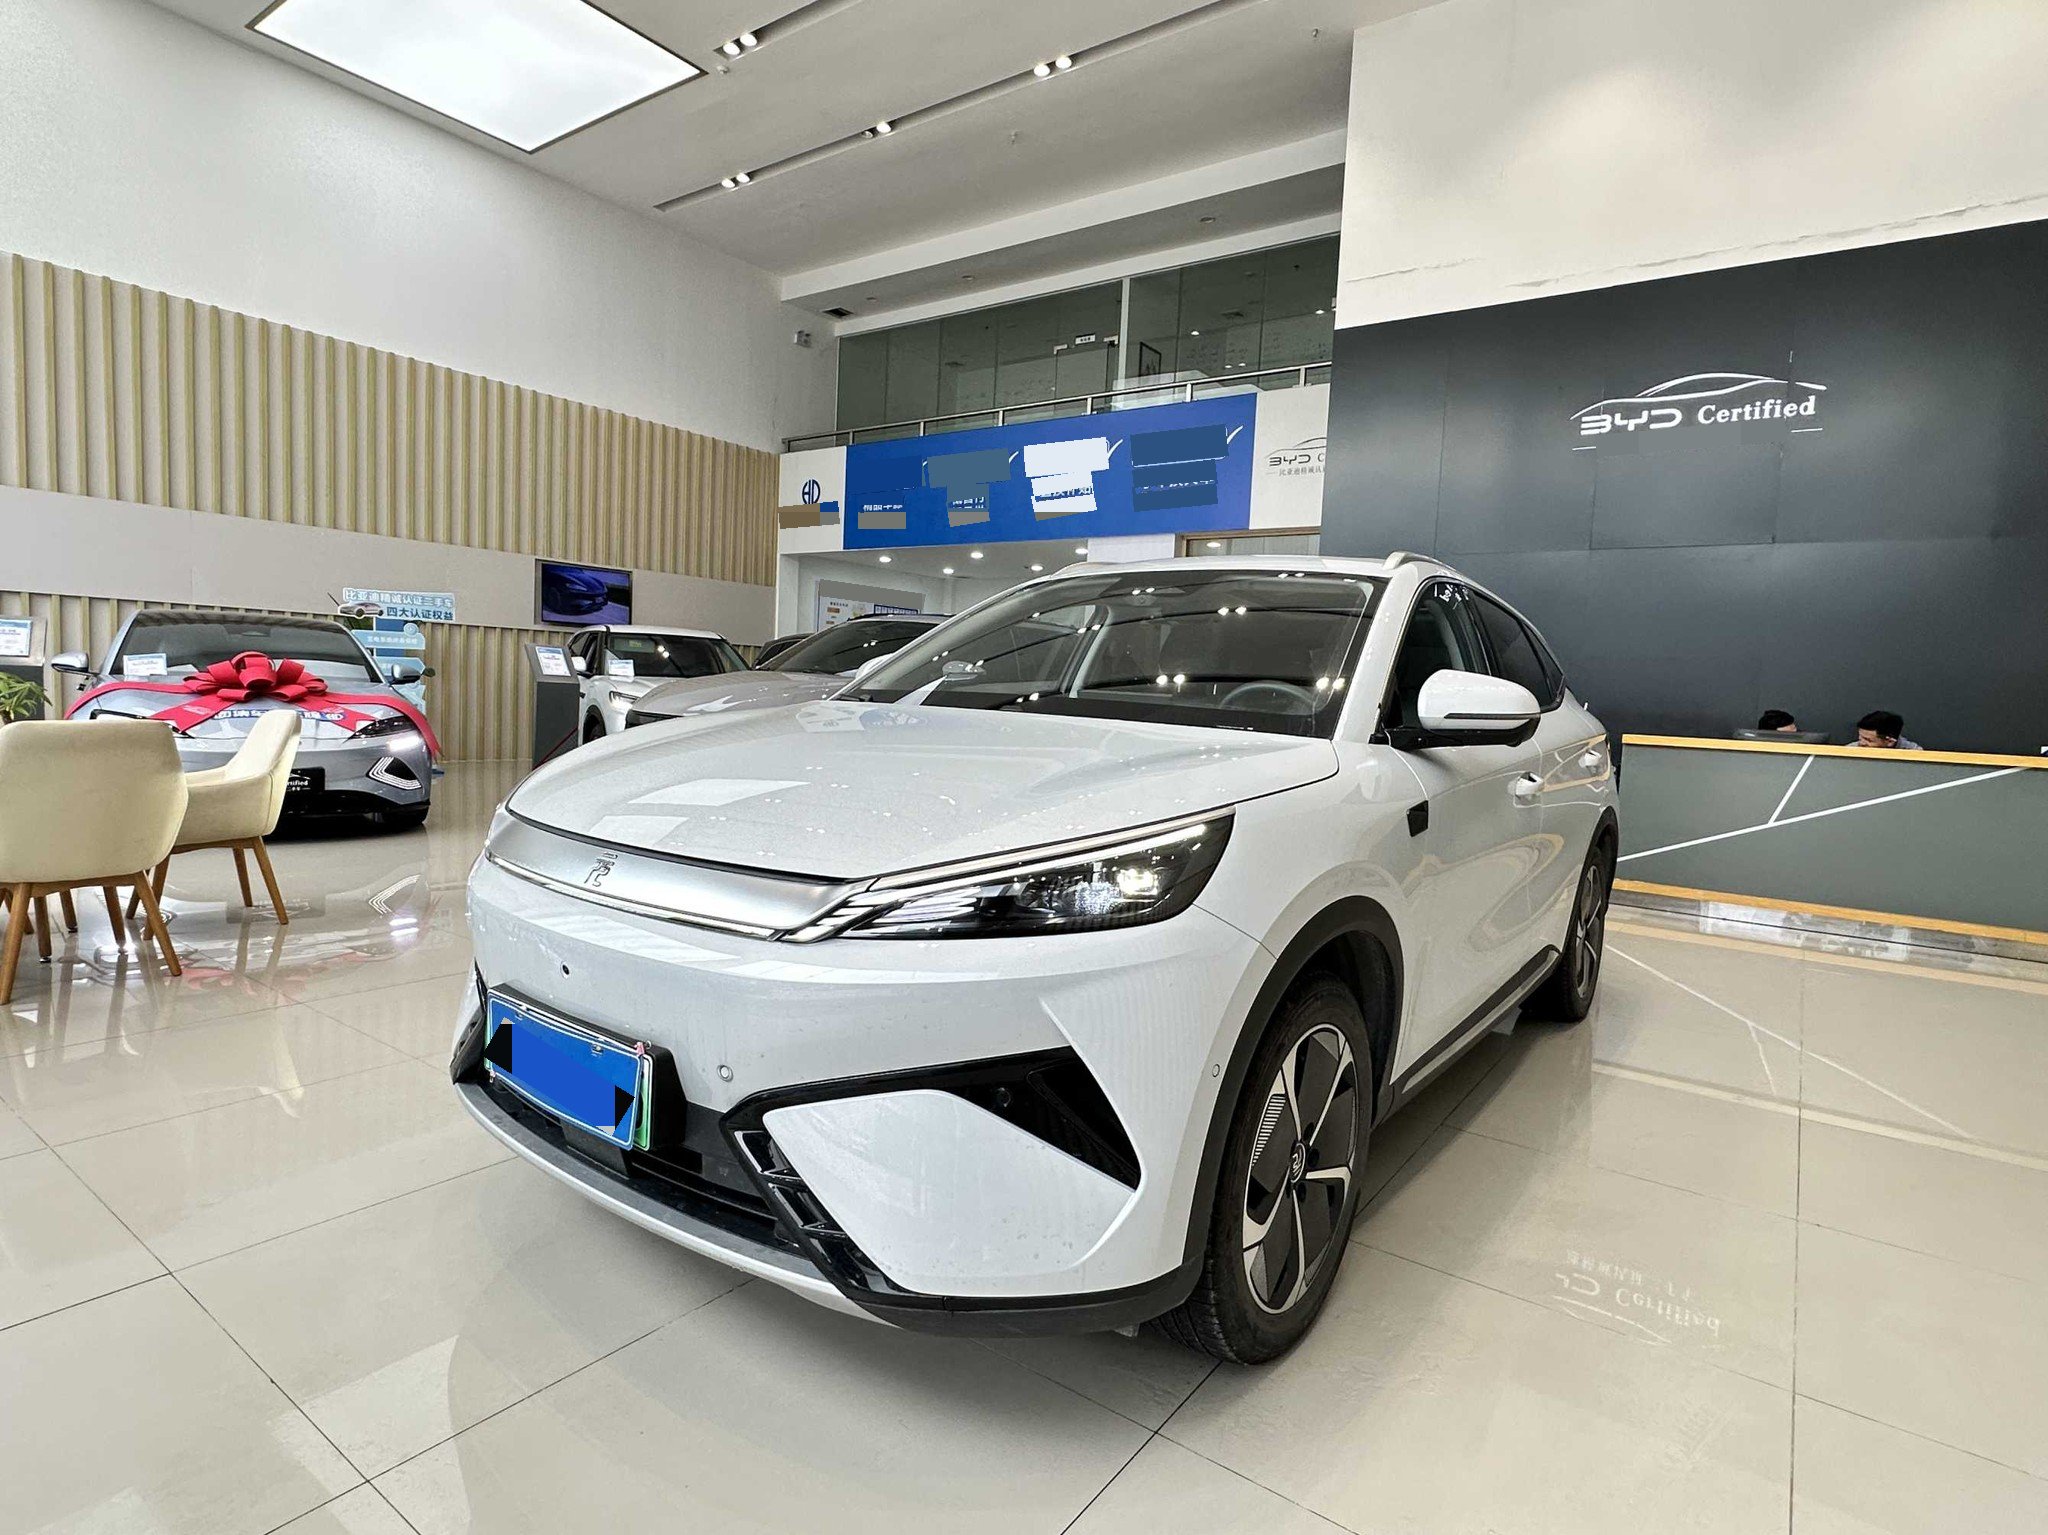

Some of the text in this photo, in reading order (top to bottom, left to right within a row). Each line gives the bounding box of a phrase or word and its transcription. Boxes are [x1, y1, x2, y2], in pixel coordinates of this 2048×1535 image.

[1580, 395, 1817, 436] BYD Certified
[1269, 455, 1311, 466] BYD
[345, 590, 453, 608] 比亚迪精诚认证二手车
[386, 606, 453, 620] 四大认证权益
